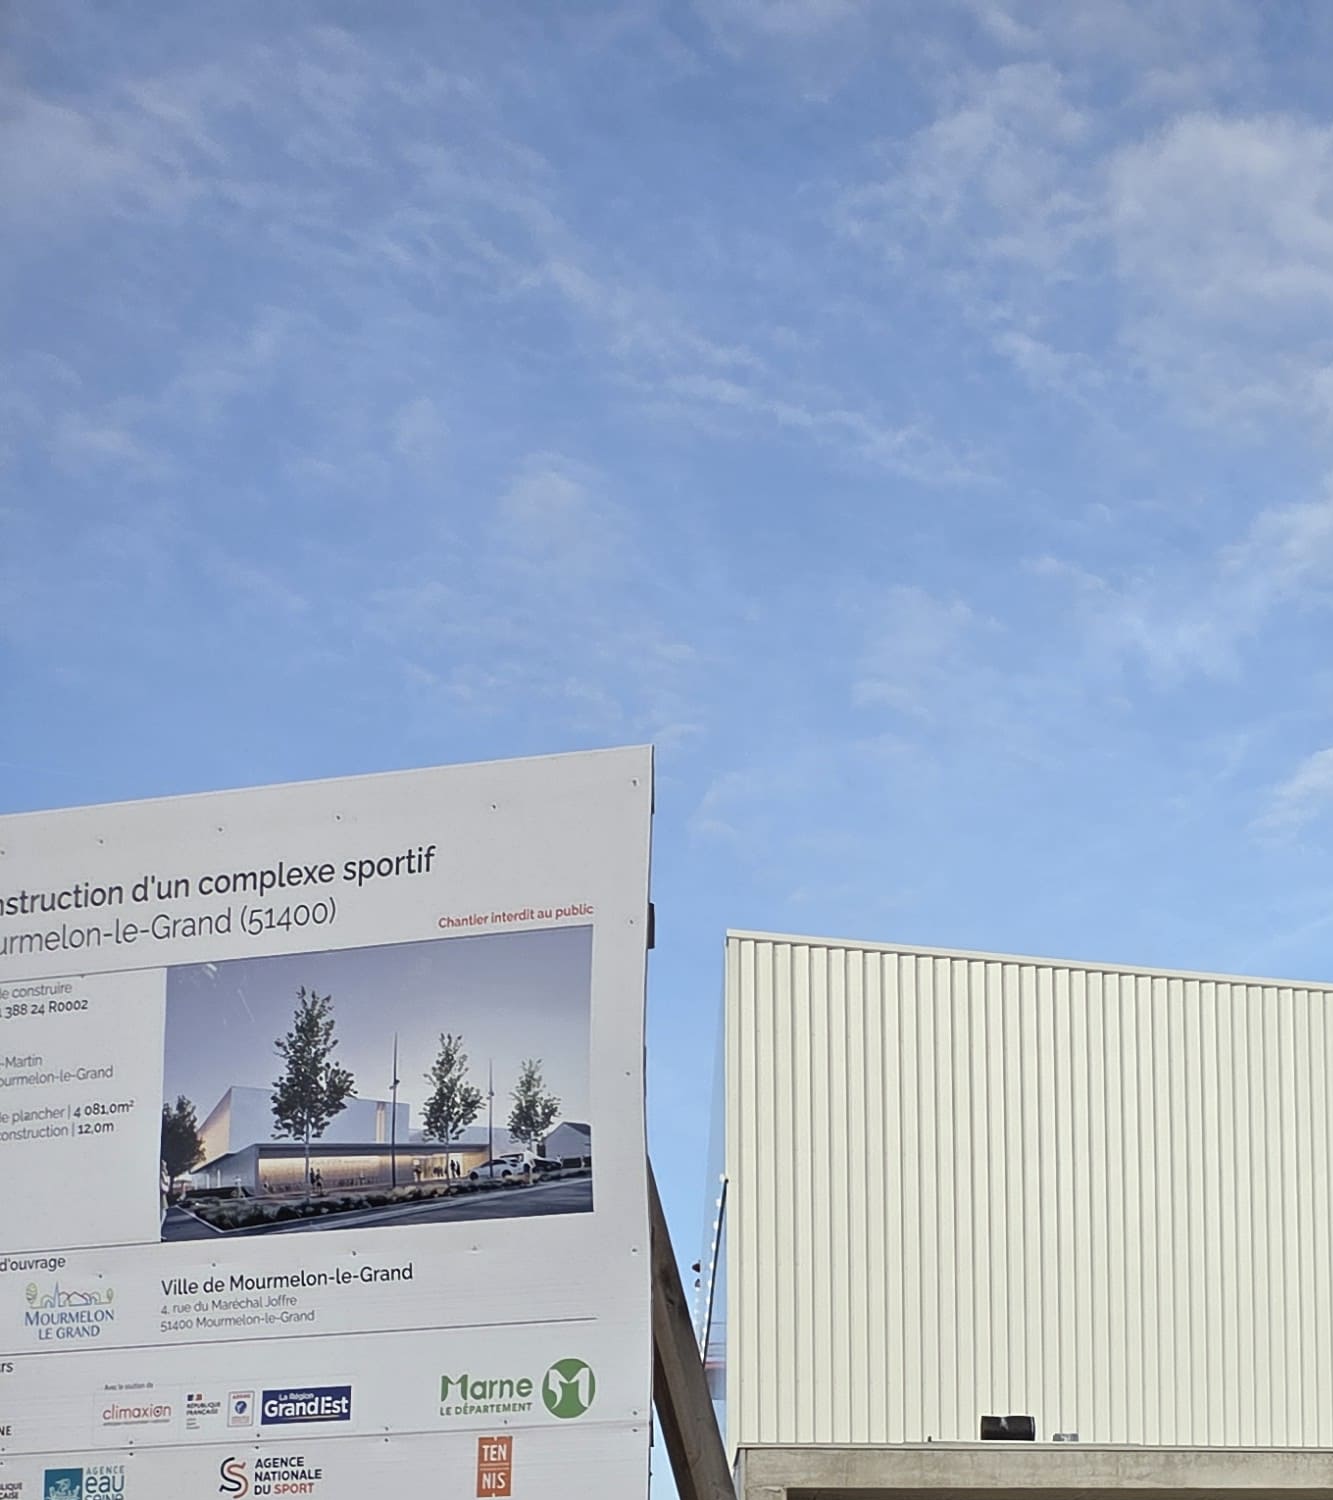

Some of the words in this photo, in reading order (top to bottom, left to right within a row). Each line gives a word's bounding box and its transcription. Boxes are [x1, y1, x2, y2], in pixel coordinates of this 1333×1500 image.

[132, 875, 189, 902] d'un
[199, 862, 335, 896] complexe
[343, 845, 436, 887] sportif
[240, 896, 336, 936] (51400)
[438, 914, 489, 928] Chantier
[491, 909, 534, 923] interdit
[537, 909, 551, 919] au
[555, 903, 594, 920] public
[12, 982, 72, 998] construire
[5, 1004, 28, 1019] 388
[31, 1004, 45, 1015] 24
[12, 1106, 65, 1124] plancher
[161, 1278, 198, 1296] Ville
[203, 1277, 225, 1293] de
[230, 1263, 413, 1292] Mourmelon-le-Grand
[173, 1303, 192, 1313] rue
[194, 1300, 209, 1312] du
[211, 1297, 263, 1311] Maréchal
[264, 1295, 297, 1308] Joffre
[25, 1309, 114, 1327] MOURMELON
[160, 1320, 193, 1332] 51400
[196, 1310, 315, 1329] Mourmelon-le-Grand
[39, 1328, 52, 1340] LE
[56, 1325, 100, 1339] GRAND
[441, 1374, 533, 1402] Marne
[440, 1406, 452, 1416] LE
[455, 1402, 533, 1415] DÉPARTEMENT
[482, 1444, 507, 1462] TEN
[86, 1465, 125, 1475] AGENCE
[255, 1456, 304, 1469] AGENCE
[254, 1469, 322, 1482] NATIONALE
[481, 1472, 506, 1489] NIS
[254, 1485, 271, 1495] DU
[274, 1482, 315, 1494] SPORT
